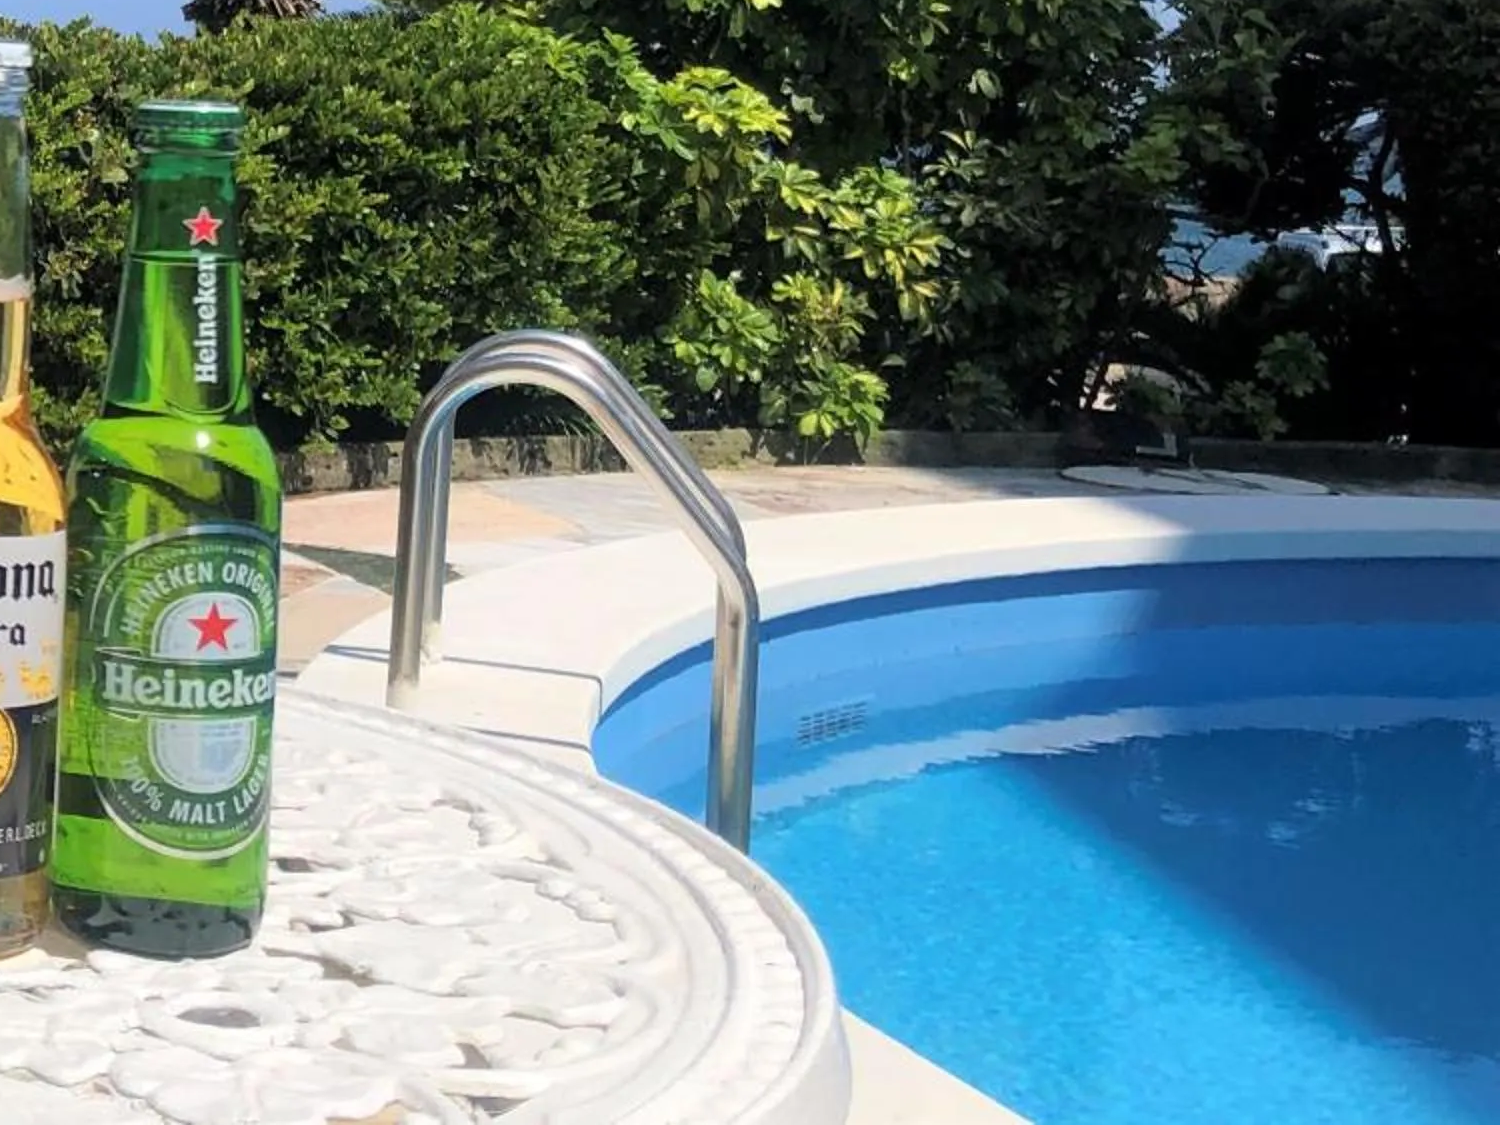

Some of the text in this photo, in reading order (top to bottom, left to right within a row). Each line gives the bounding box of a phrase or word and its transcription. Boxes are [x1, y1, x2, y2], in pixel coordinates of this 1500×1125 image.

[193, 254, 218, 384] Heineken
[119, 562, 213, 635] HEINEKEN
[169, 799, 227, 825] MALT
